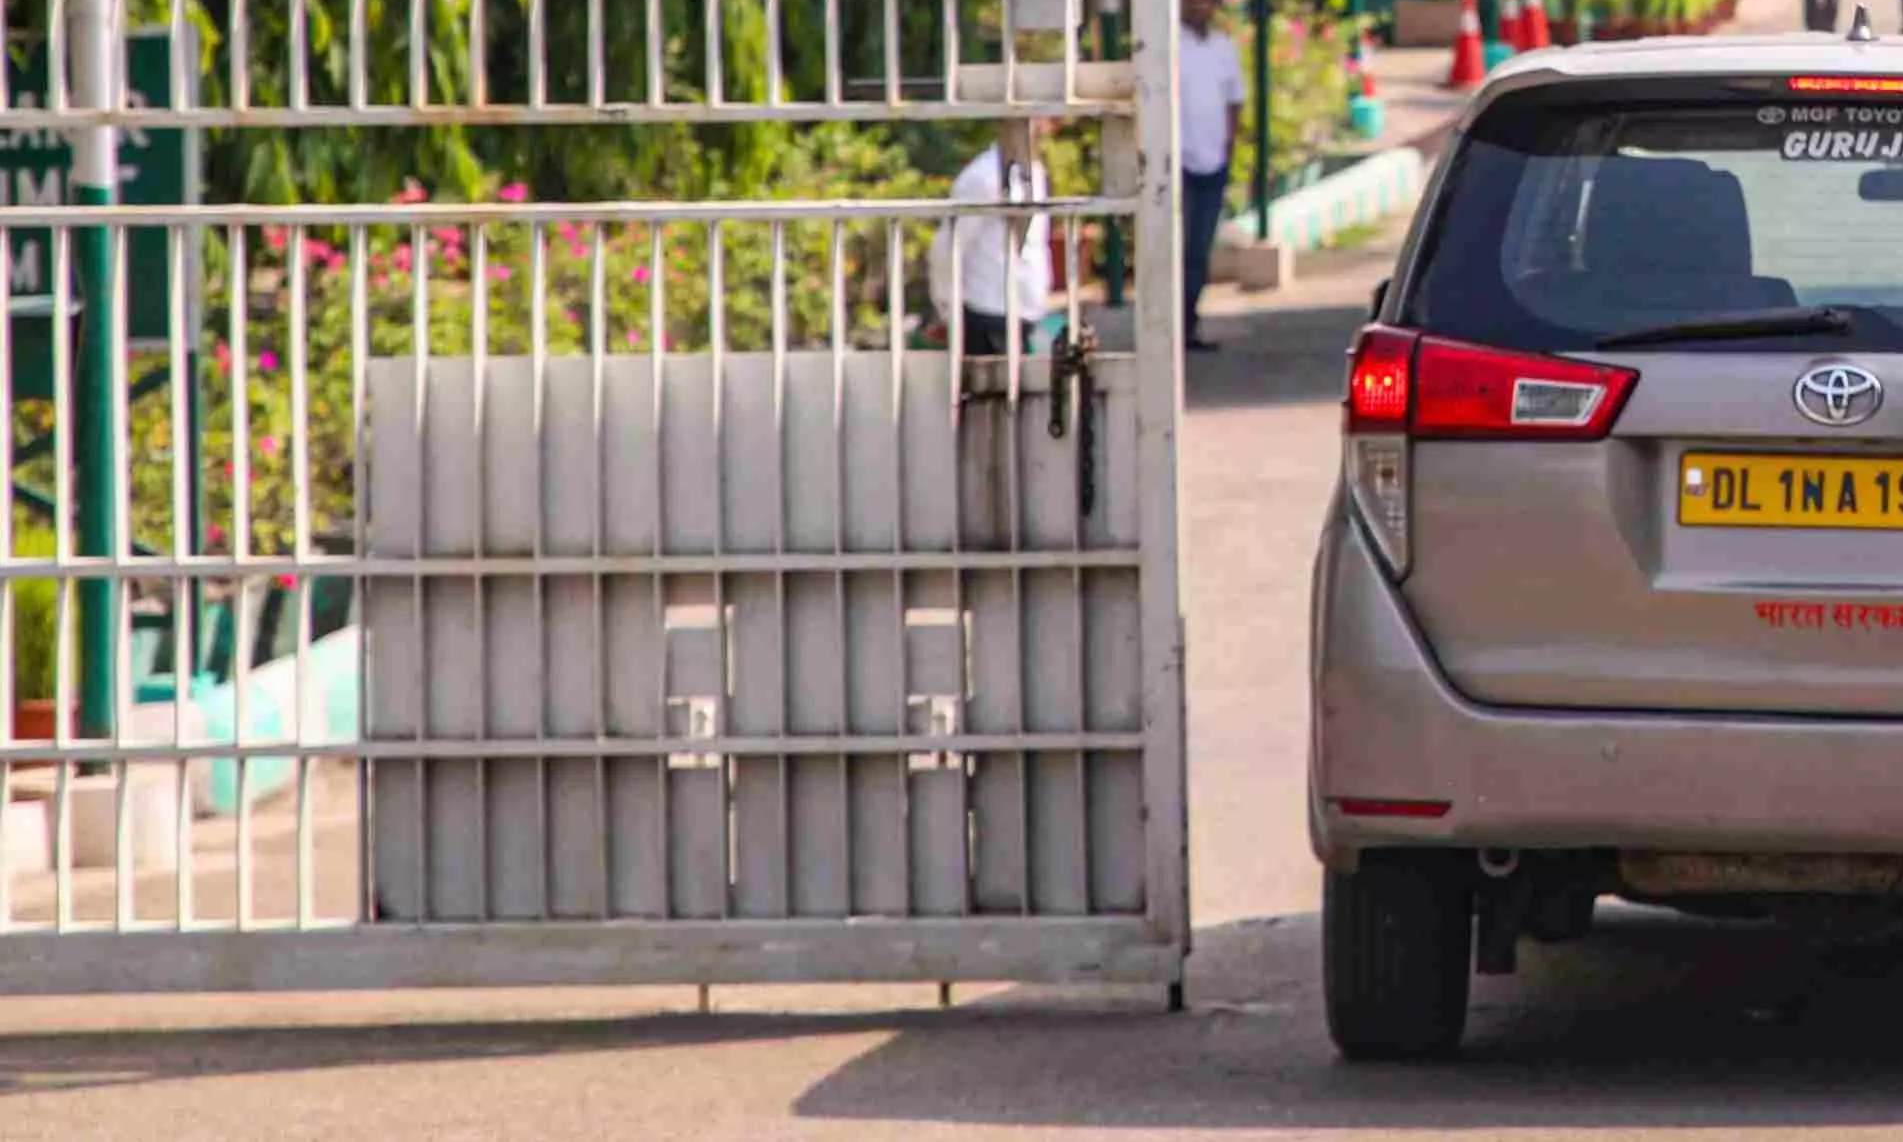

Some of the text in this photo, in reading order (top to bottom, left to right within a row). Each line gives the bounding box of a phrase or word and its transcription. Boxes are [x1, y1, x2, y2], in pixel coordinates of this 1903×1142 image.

[1791, 106, 1837, 122] MGF
[1712, 468, 1761, 510] DL
[1754, 601, 1825, 632] भारत
